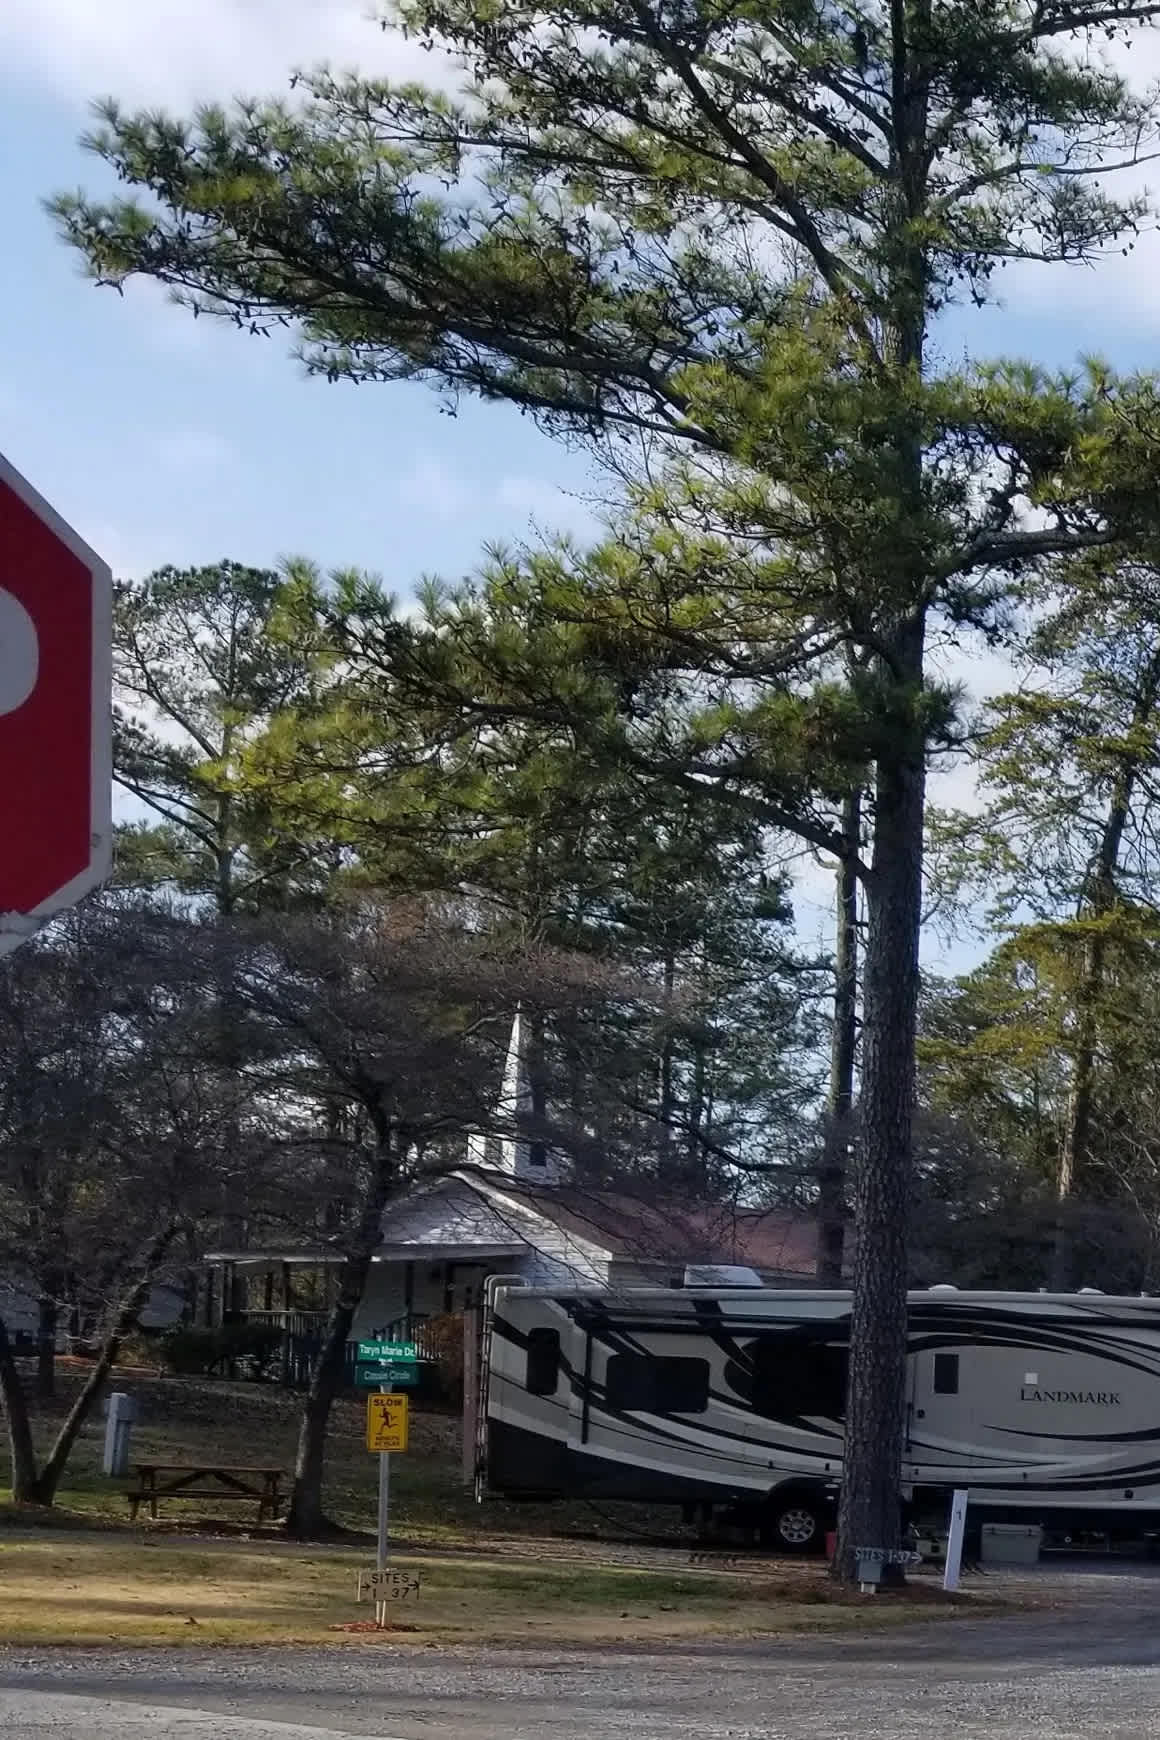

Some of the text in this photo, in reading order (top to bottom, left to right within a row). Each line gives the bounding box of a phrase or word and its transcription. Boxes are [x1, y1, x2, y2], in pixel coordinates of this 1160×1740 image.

[381, 1345, 403, 1356] Marie
[1020, 1388, 1121, 1405] LANDMARK
[371, 1573, 410, 1584] SITES
